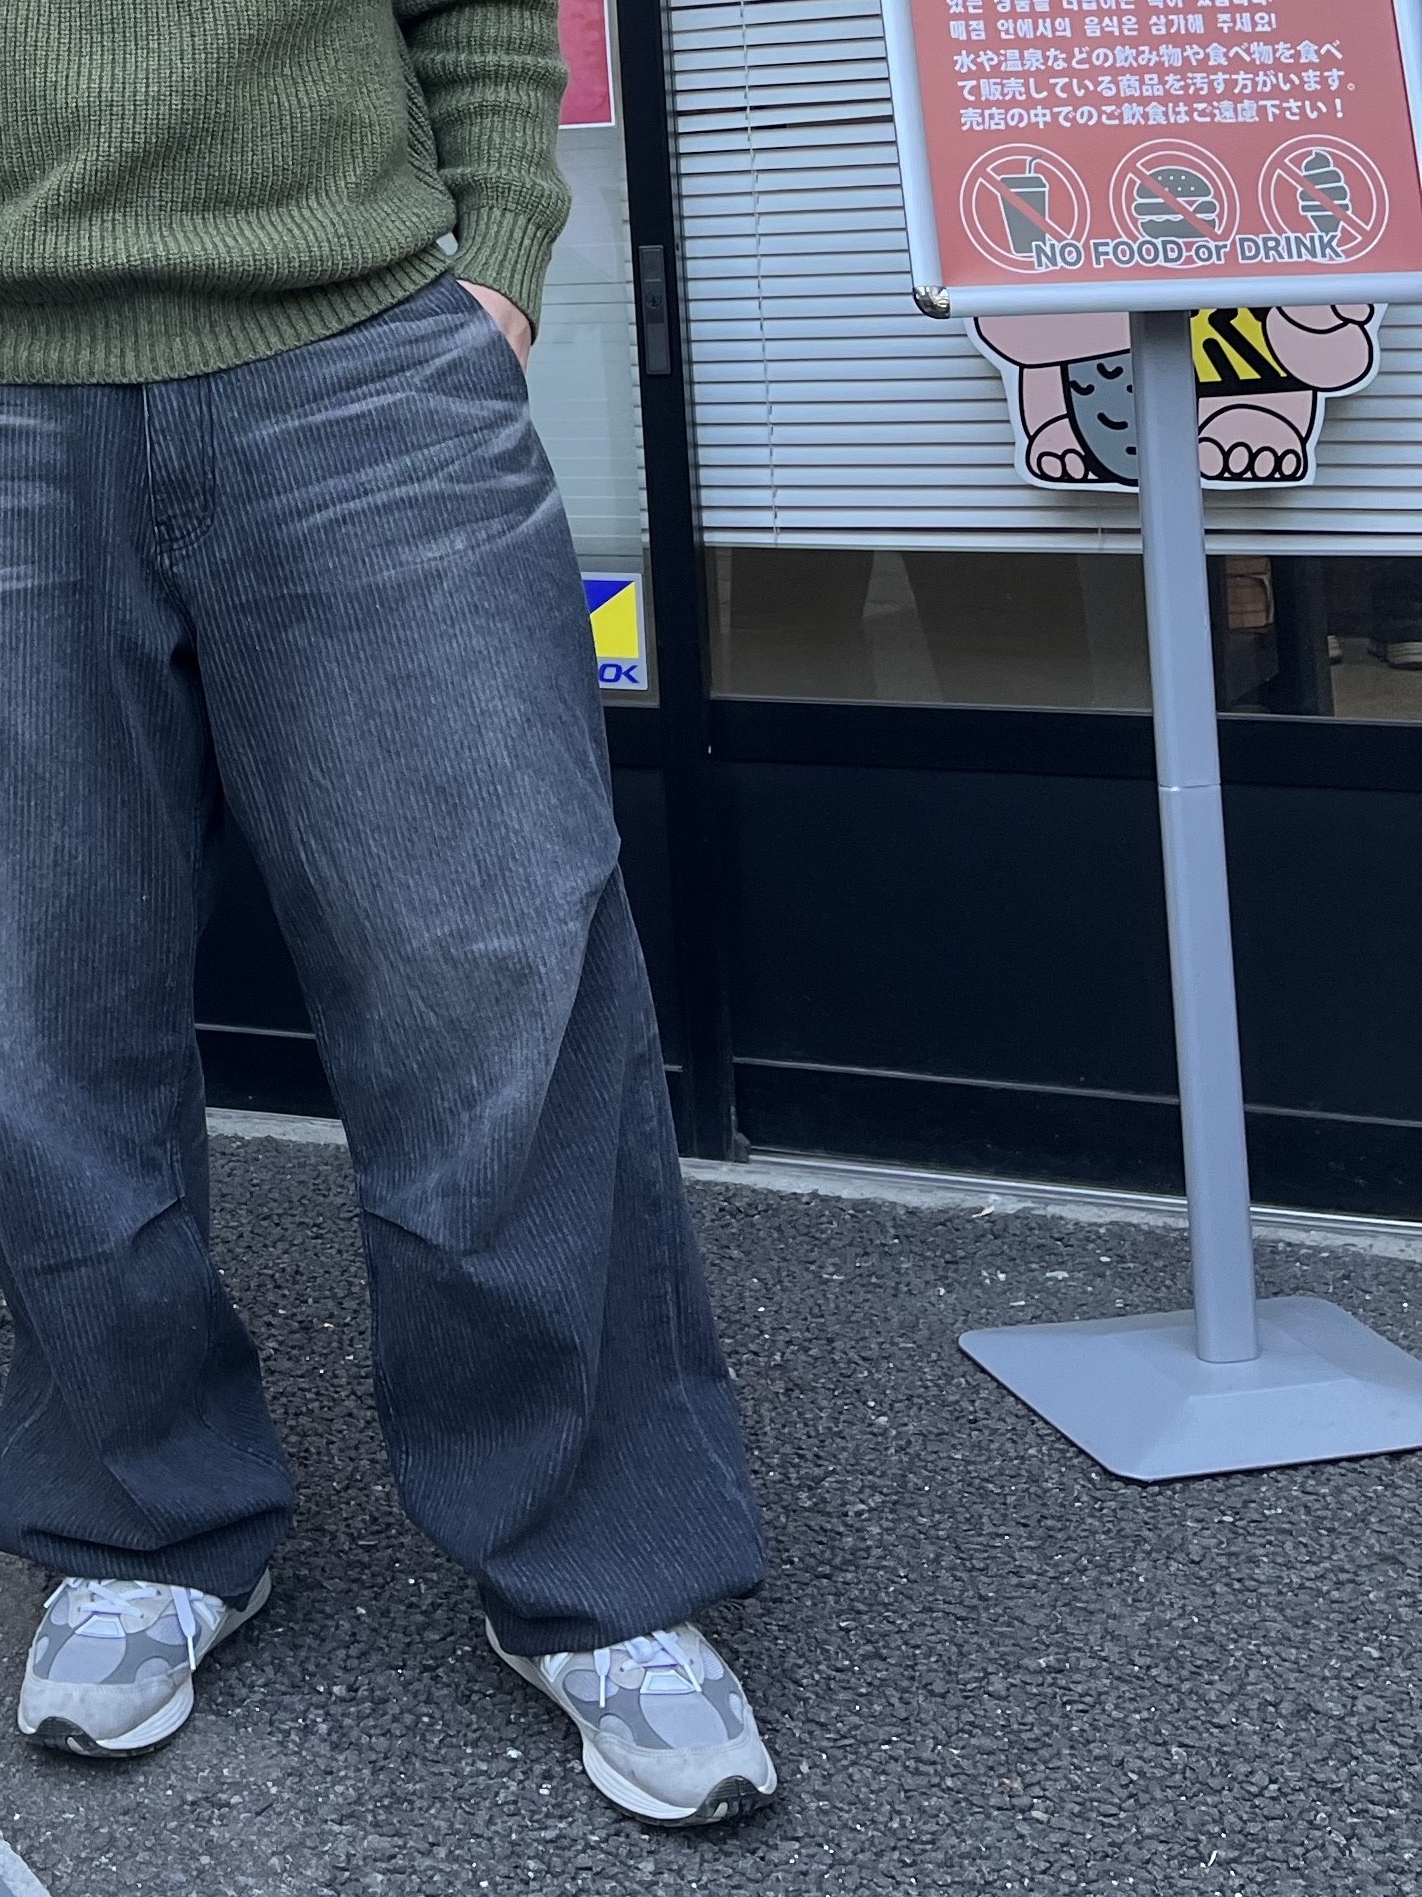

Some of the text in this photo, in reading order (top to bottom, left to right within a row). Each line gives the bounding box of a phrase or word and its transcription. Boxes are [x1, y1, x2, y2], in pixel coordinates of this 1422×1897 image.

[949, 19, 987, 41] 매점
[996, 17, 1072, 40] 안에서의
[1084, 15, 1139, 37] 음식은
[1148, 13, 1205, 35] 삼가해
[953, 39, 1343, 74] 水や温泉などの飲み物や食べ物を食べ
[957, 68, 1356, 102] て販売している商品を汚す方がいます。
[1033, 233, 1343, 269] NO FOOD or DRINK
